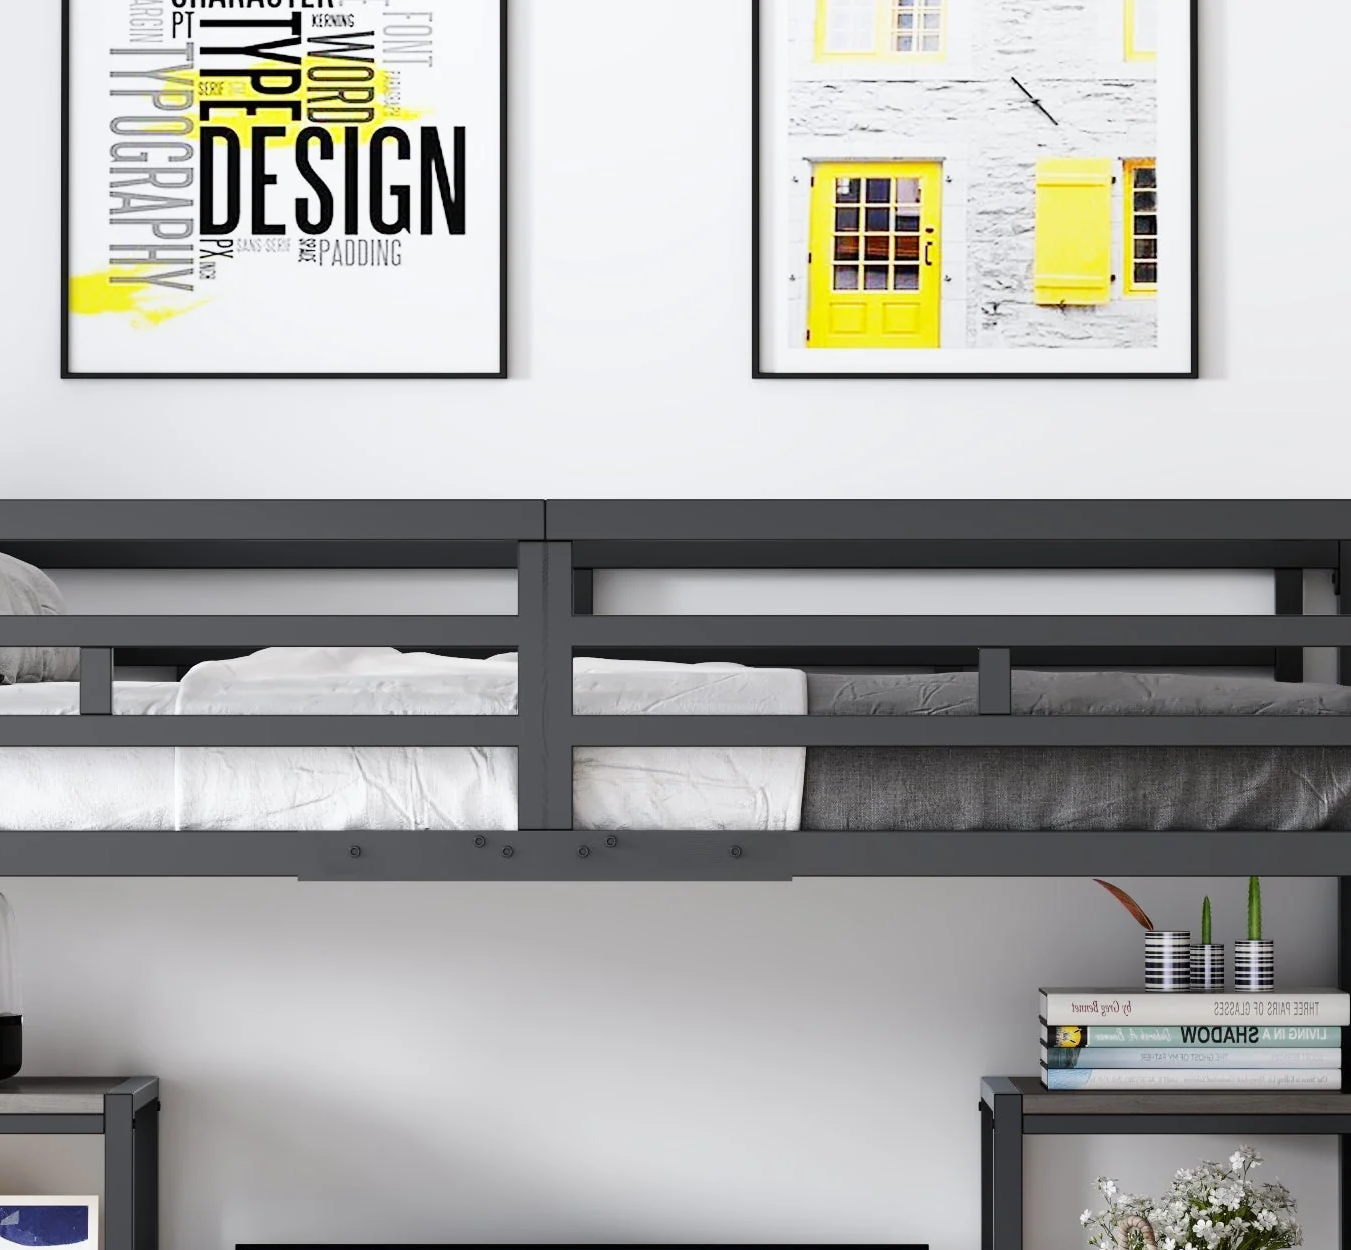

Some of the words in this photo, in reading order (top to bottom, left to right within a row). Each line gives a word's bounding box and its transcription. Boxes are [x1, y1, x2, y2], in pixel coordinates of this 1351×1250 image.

[129, 0, 163, 43] ARGIN
[172, 11, 194, 39] PT
[311, 14, 355, 28] KERNING
[383, 12, 433, 68] FONT
[199, 11, 302, 121] TYPE
[307, 30, 375, 123] WORD
[109, 42, 194, 292] TYPOGRAPHY
[199, 126, 466, 235] DESIGN
[199, 239, 233, 259] PX
[319, 239, 402, 267] PADDING
